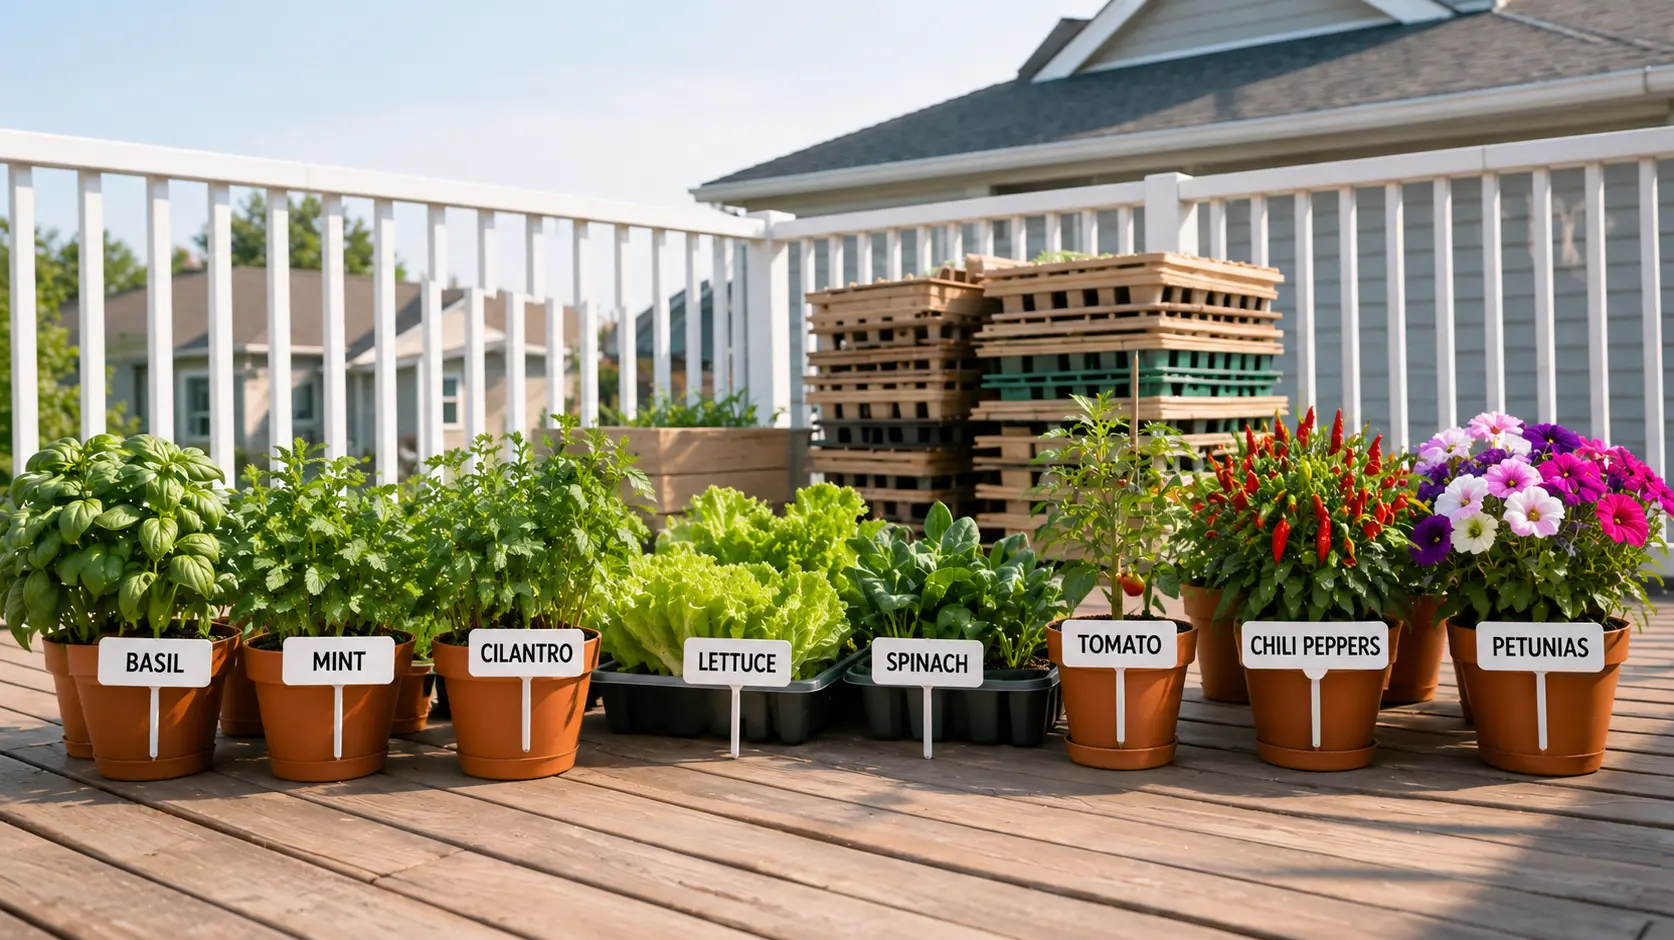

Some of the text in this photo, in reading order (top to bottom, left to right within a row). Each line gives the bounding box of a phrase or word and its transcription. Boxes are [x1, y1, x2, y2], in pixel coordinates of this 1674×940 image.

[480, 642, 573, 664] CILANTRO
[1077, 634, 1162, 655] TOMATO
[1250, 635, 1381, 656] CHILI PEPPERS
[1492, 636, 1590, 658] PETUNIAS
[126, 651, 185, 674] BASIL
[312, 650, 367, 672] MINT
[698, 651, 777, 674] LETTUCE
[886, 651, 968, 674] SPINACH
